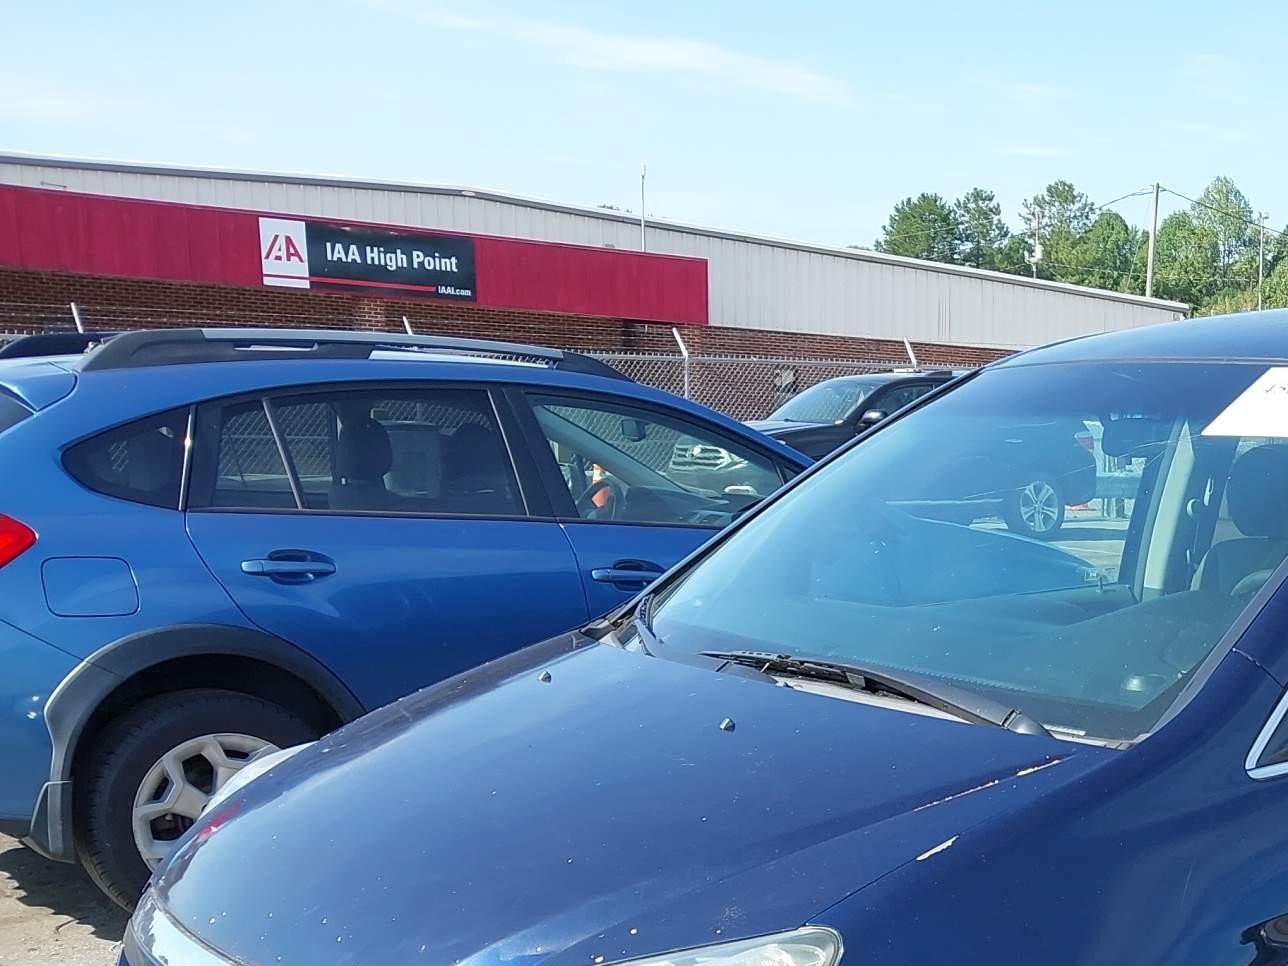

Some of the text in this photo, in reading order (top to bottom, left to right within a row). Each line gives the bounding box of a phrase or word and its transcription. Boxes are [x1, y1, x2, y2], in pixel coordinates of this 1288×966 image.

[325, 241, 459, 273] IAA High Point
